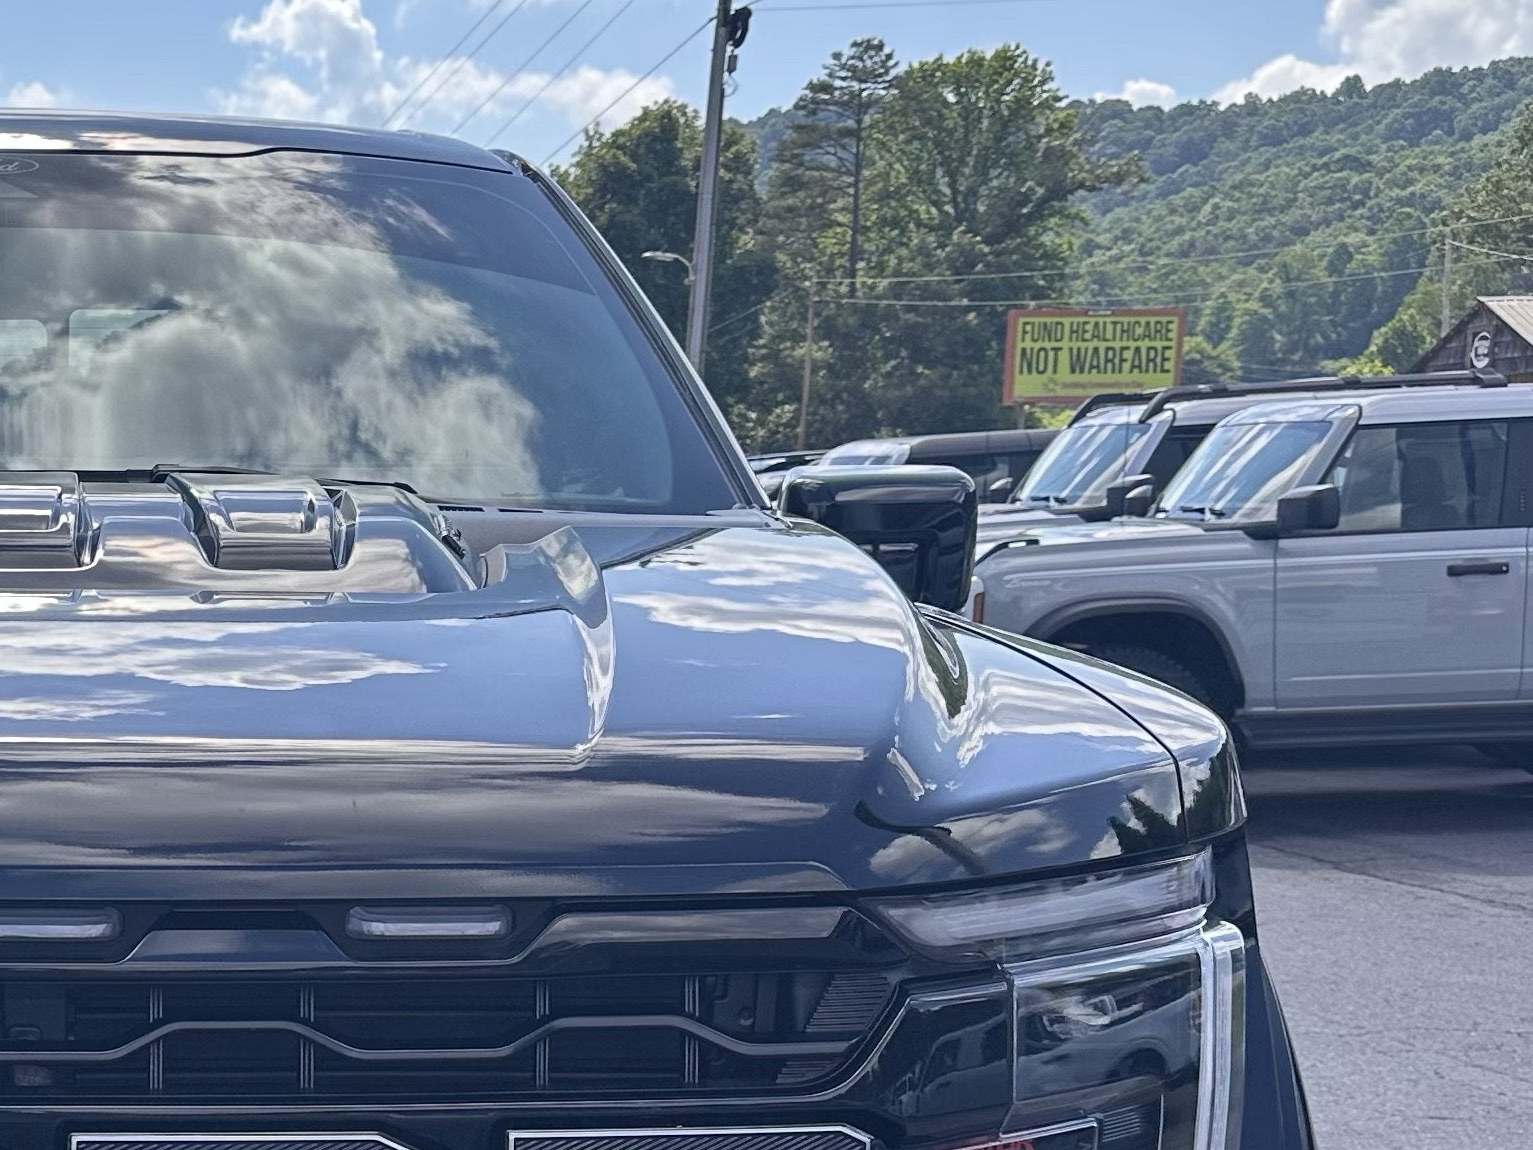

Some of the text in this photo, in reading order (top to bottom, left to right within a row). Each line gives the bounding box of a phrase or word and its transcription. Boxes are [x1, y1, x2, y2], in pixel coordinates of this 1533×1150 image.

[1021, 320, 1174, 342] FUND HEALTHCARE
[1019, 346, 1172, 375] NOT WARFARE
